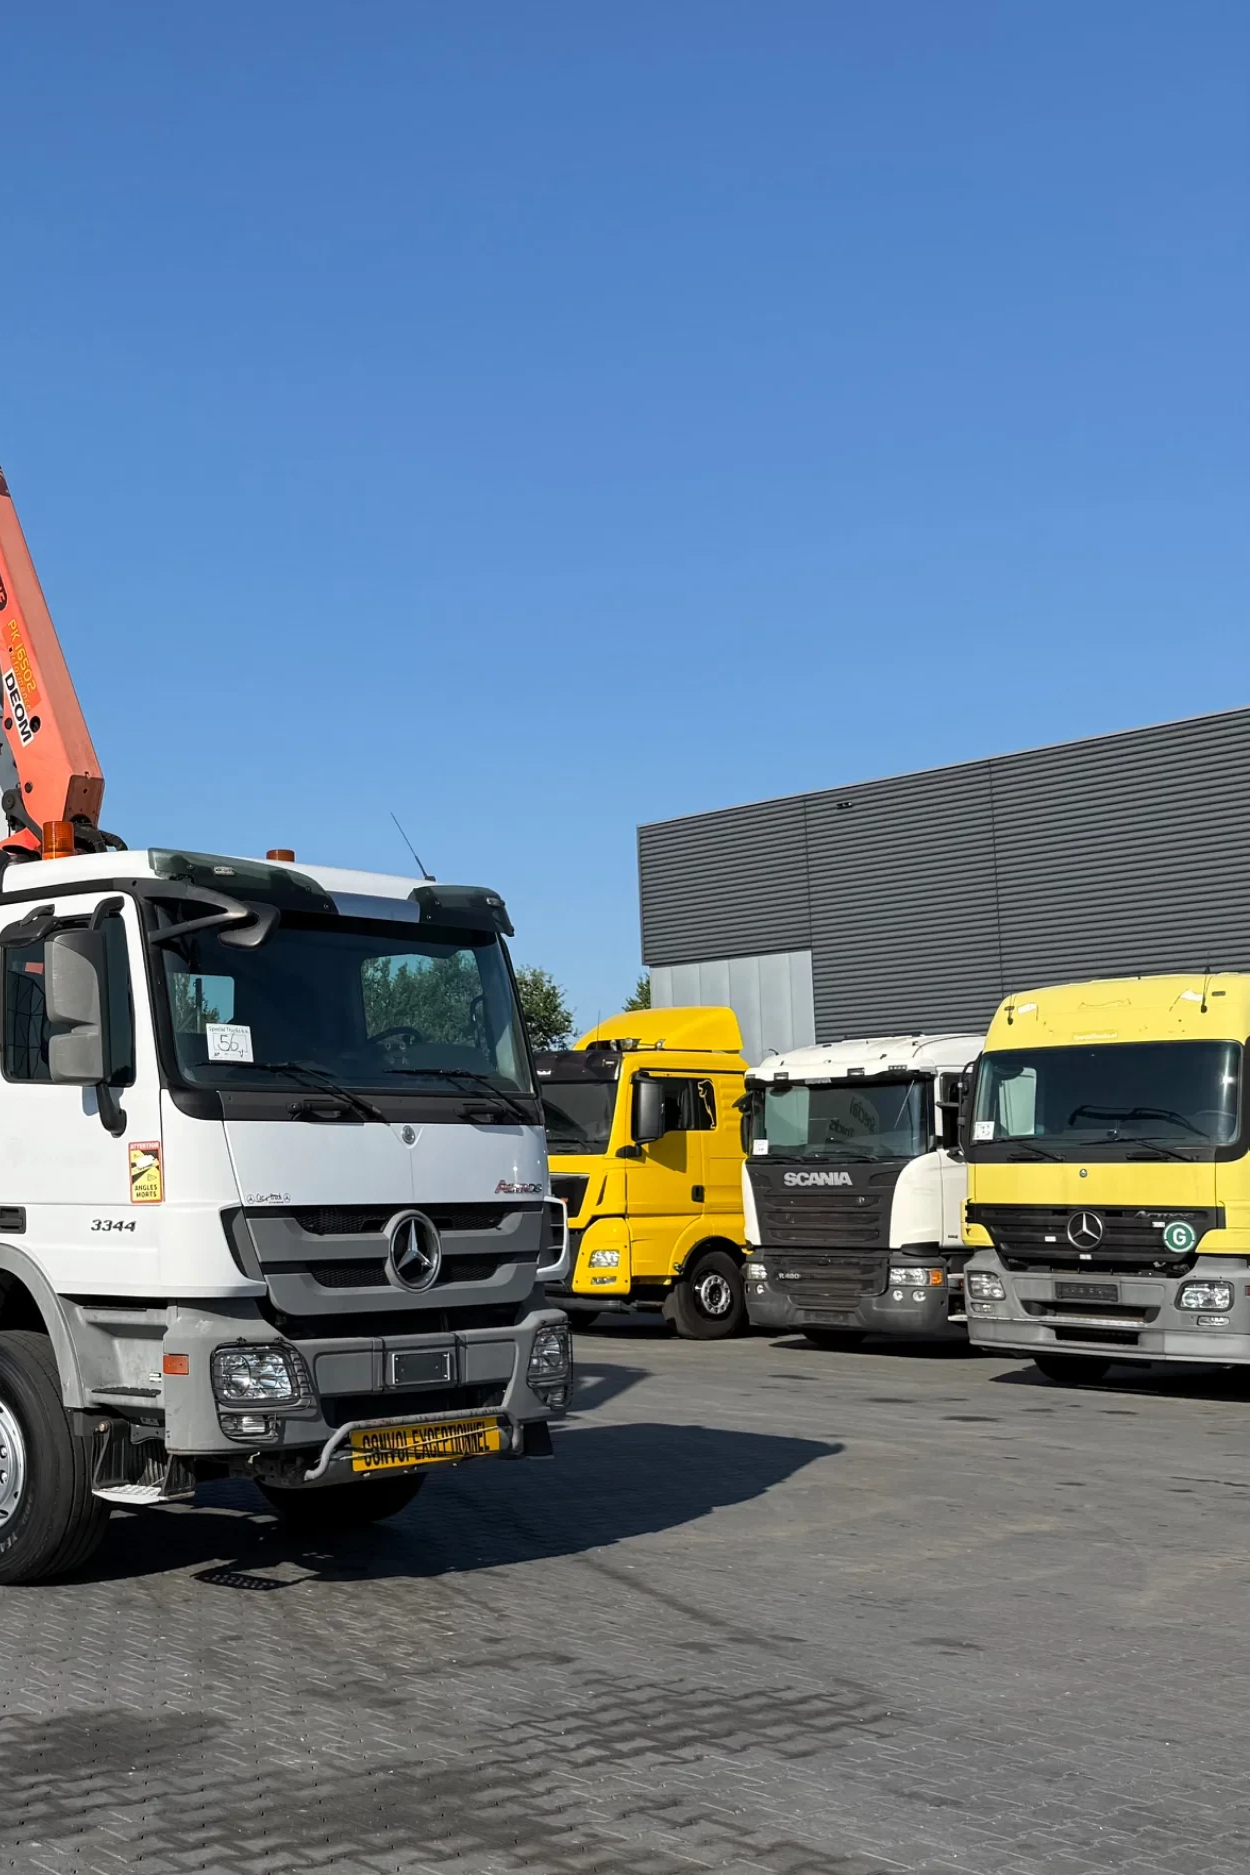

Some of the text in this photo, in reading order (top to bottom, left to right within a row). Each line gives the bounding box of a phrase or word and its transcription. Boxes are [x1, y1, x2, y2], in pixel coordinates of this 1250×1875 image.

[8, 619, 37, 693] PK 16502
[5, 672, 32, 743] DEOM
[783, 1171, 853, 1187] SCANIA
[90, 1218, 137, 1232] 3344
[1172, 1227, 1187, 1246] G
[362, 1420, 490, 1467] CONVOI EXCEPTIONNEL
